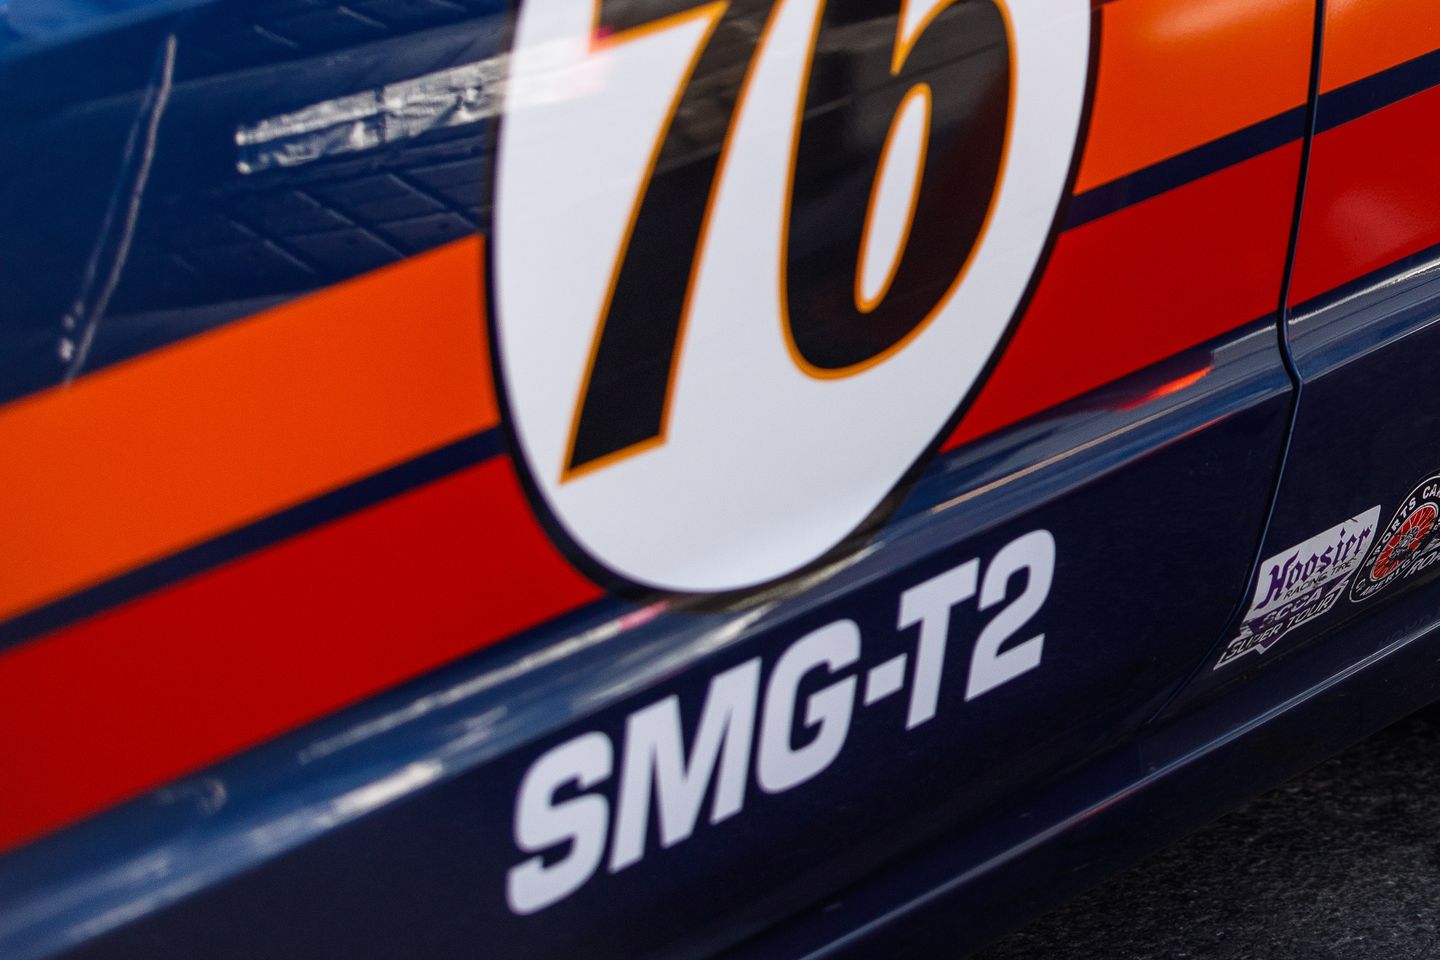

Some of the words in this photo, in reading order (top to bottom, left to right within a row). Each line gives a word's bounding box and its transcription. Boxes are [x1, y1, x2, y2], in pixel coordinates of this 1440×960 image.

[1254, 526, 1371, 610] Hoosier
[1283, 575, 1329, 600] RACING
[1225, 623, 1283, 660] SUPER
[1287, 593, 1335, 628] TOUR
[1260, 587, 1323, 628] SCCA
[506, 529, 1056, 916] SMG-T2
